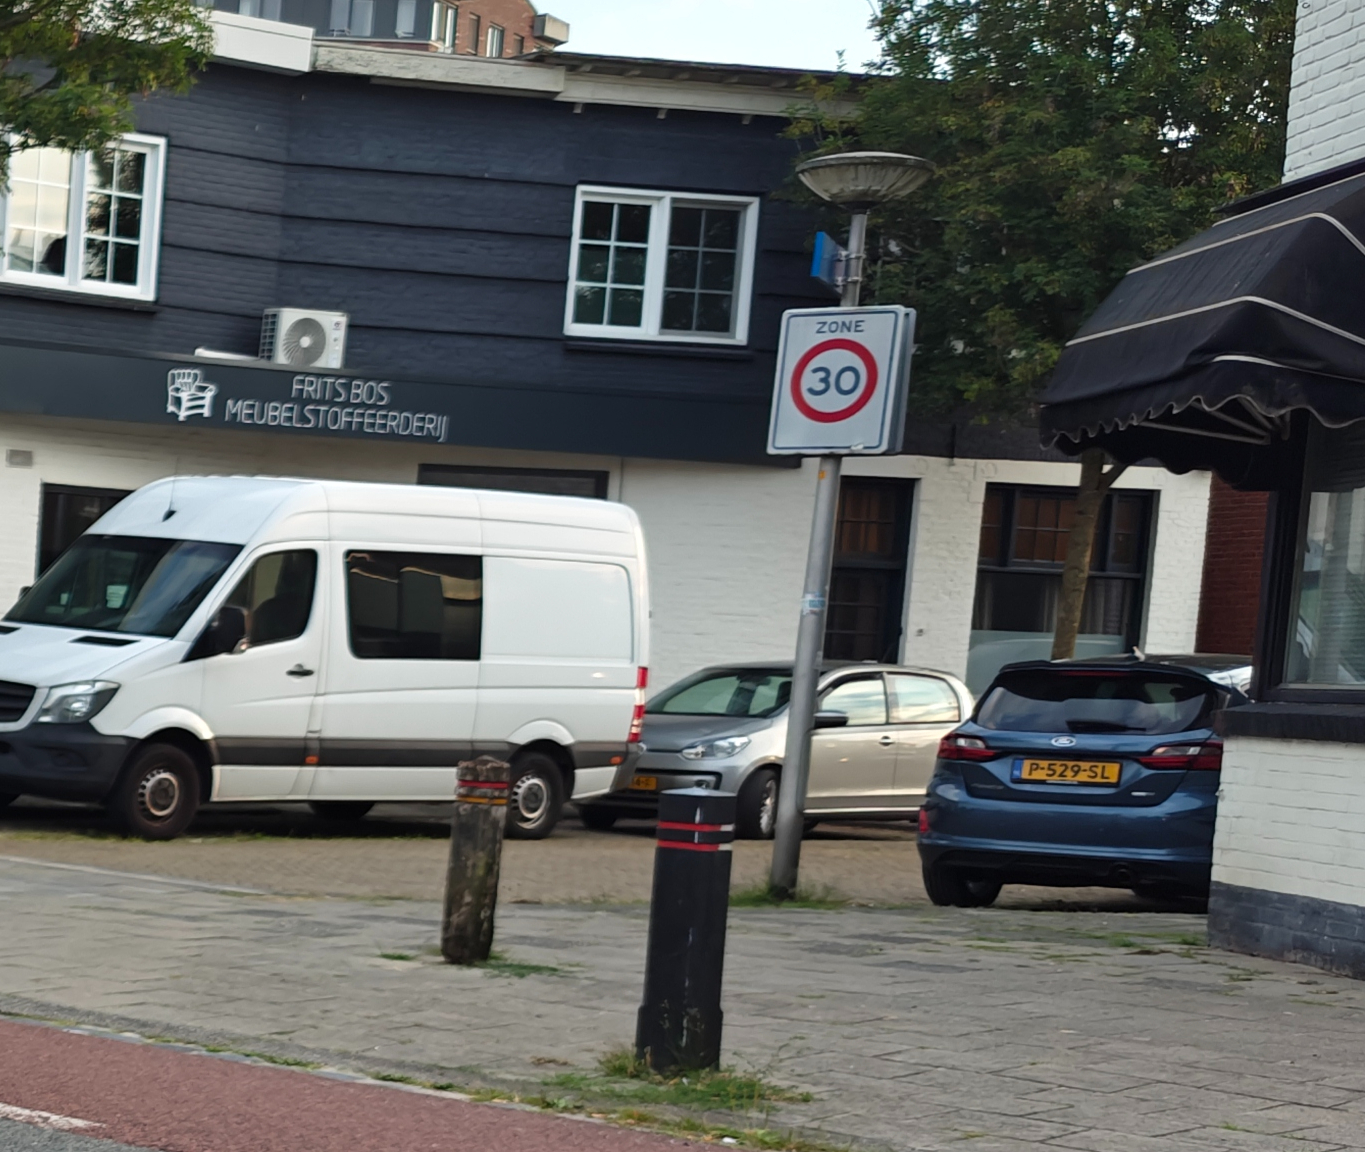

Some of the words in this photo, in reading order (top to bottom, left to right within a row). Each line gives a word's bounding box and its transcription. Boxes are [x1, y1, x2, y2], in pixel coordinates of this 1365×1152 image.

[815, 319, 866, 334] ZONE
[291, 374, 351, 403] FRITS
[349, 379, 392, 406] BOS
[806, 365, 861, 397] 30
[224, 398, 450, 443] MEUBELSTOFFEERDERIJ
[1027, 761, 1111, 780] P-529-SL
